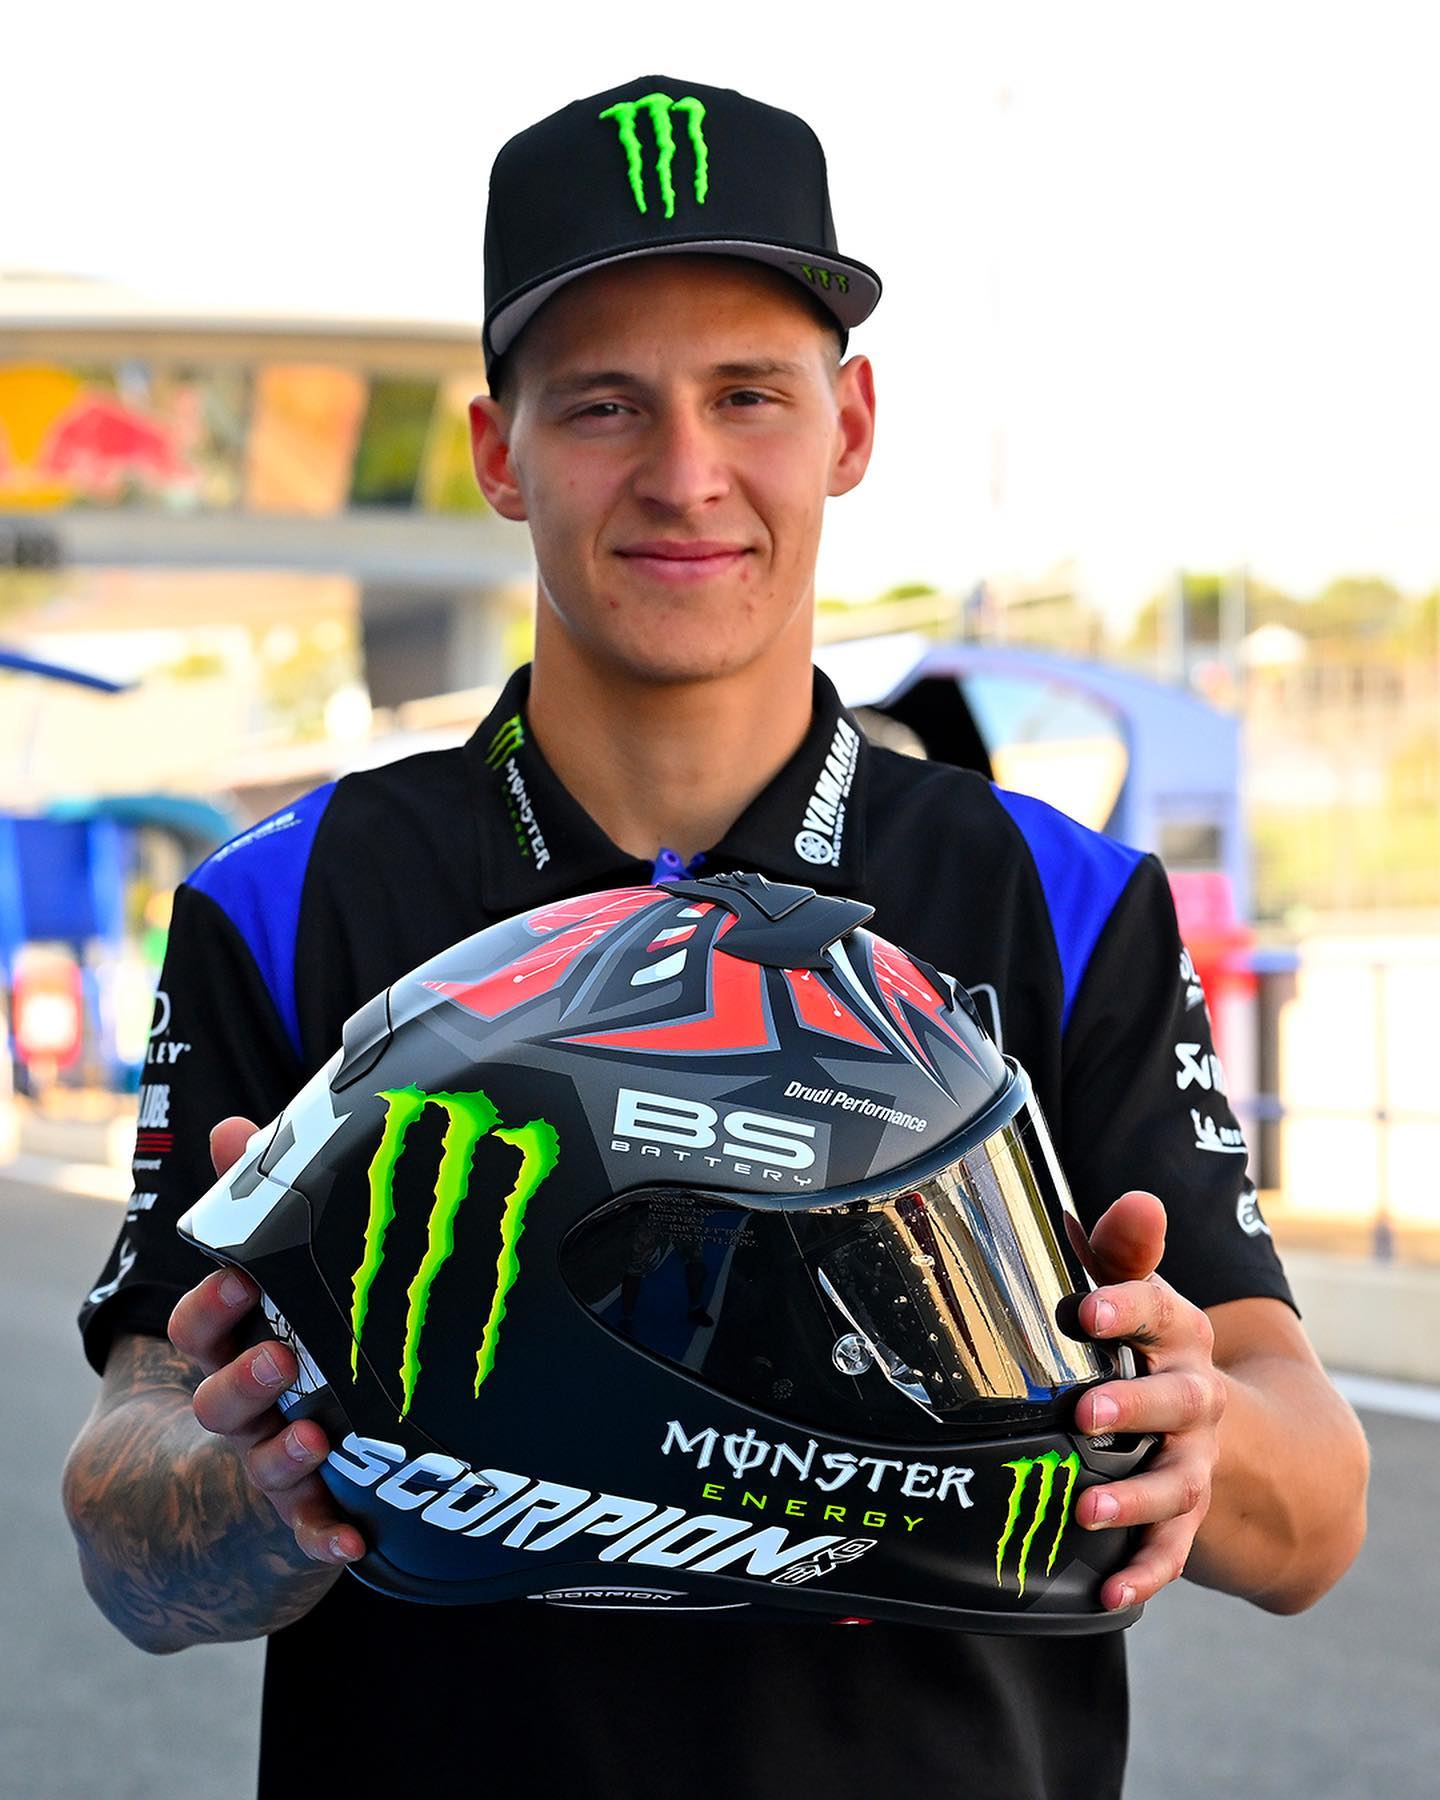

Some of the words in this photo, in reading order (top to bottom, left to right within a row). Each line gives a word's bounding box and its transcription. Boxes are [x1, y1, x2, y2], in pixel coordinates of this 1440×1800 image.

[505, 757, 551, 871] MONSTER
[802, 717, 856, 837] YAMAHA
[612, 1087, 817, 1170] BS
[783, 1080, 833, 1105] Drudi
[829, 1090, 928, 1133] Performance
[610, 1140, 813, 1187] BATTERY
[327, 1431, 847, 1576] SCORPION
[660, 1419, 975, 1510] MONSTER
[702, 1482, 924, 1532] ENERGY
